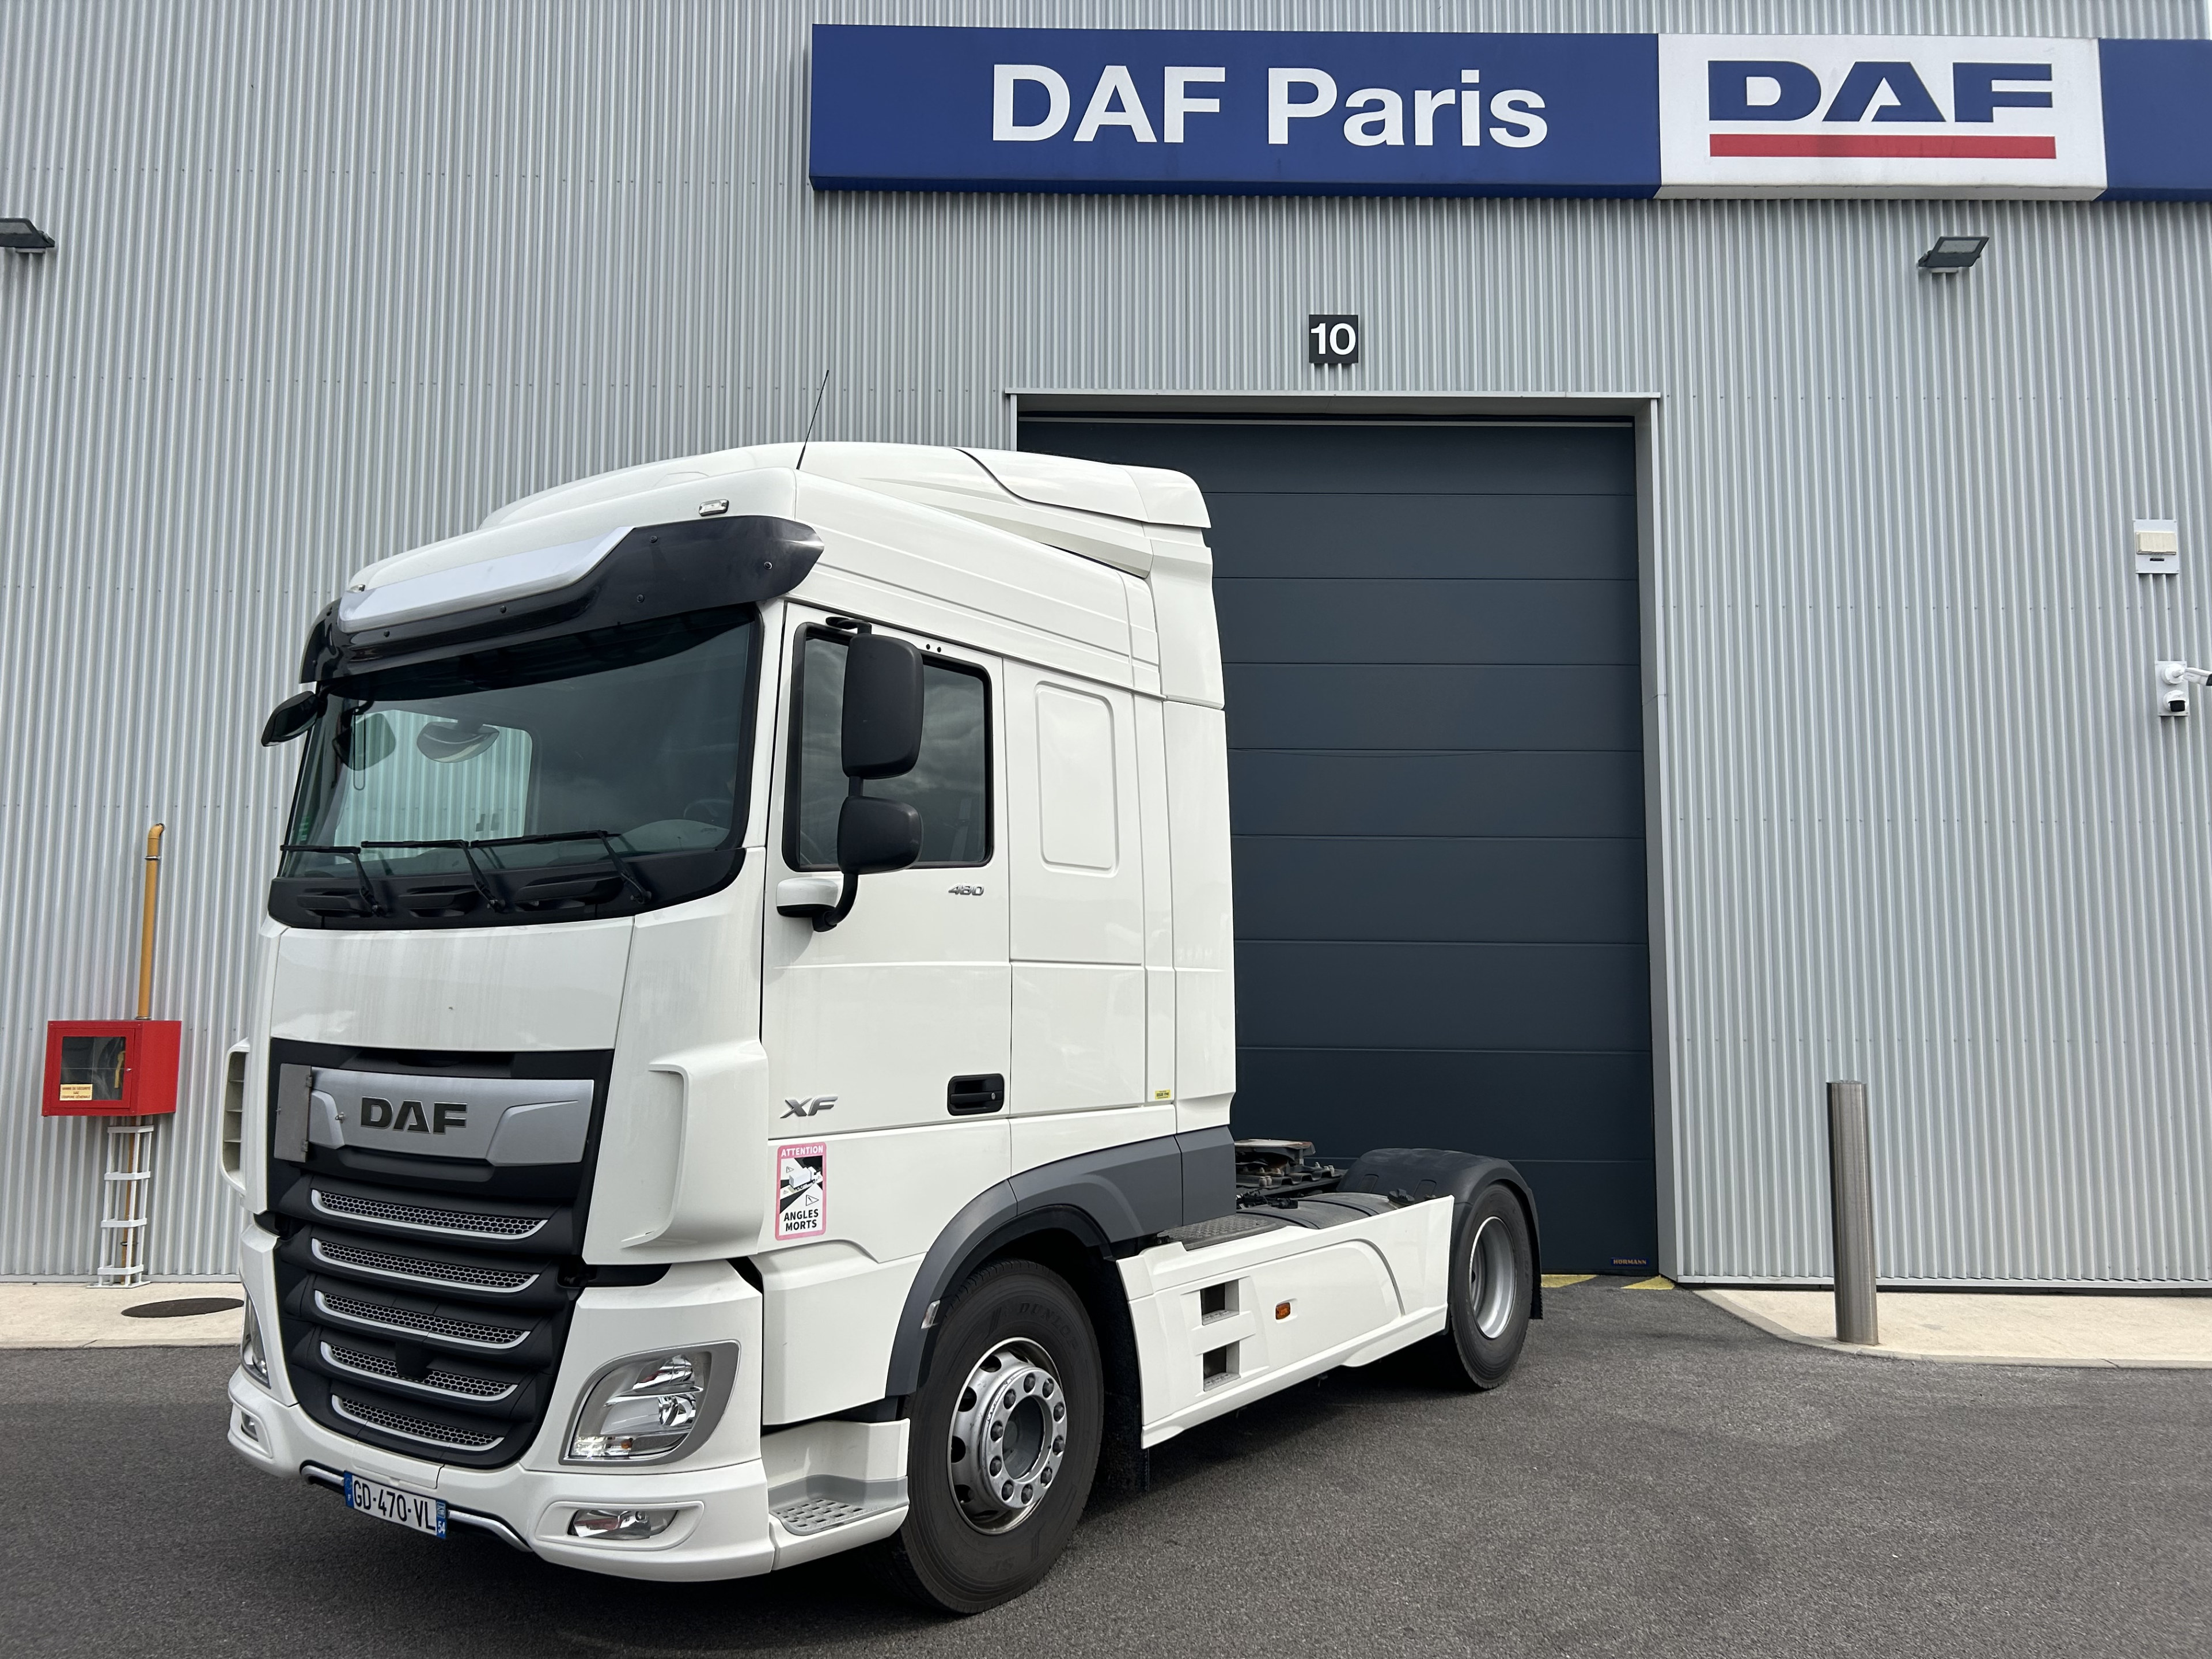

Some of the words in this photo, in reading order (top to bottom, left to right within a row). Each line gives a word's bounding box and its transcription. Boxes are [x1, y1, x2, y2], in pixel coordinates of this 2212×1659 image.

[1708, 60, 2052, 122] DAF
[993, 65, 1225, 142] DAF
[1268, 68, 1547, 147] Paris
[1310, 323, 1356, 355] 10
[948, 885, 984, 896] 480
[361, 1096, 467, 1135] DAF
[779, 1096, 838, 1119] XF
[781, 1145, 824, 1157] ATTENTION
[783, 1209, 819, 1222] ANGLES
[785, 1219, 817, 1232] MORTS
[353, 1479, 436, 1532] GD-470-VL
[438, 1520, 446, 1535] 54
